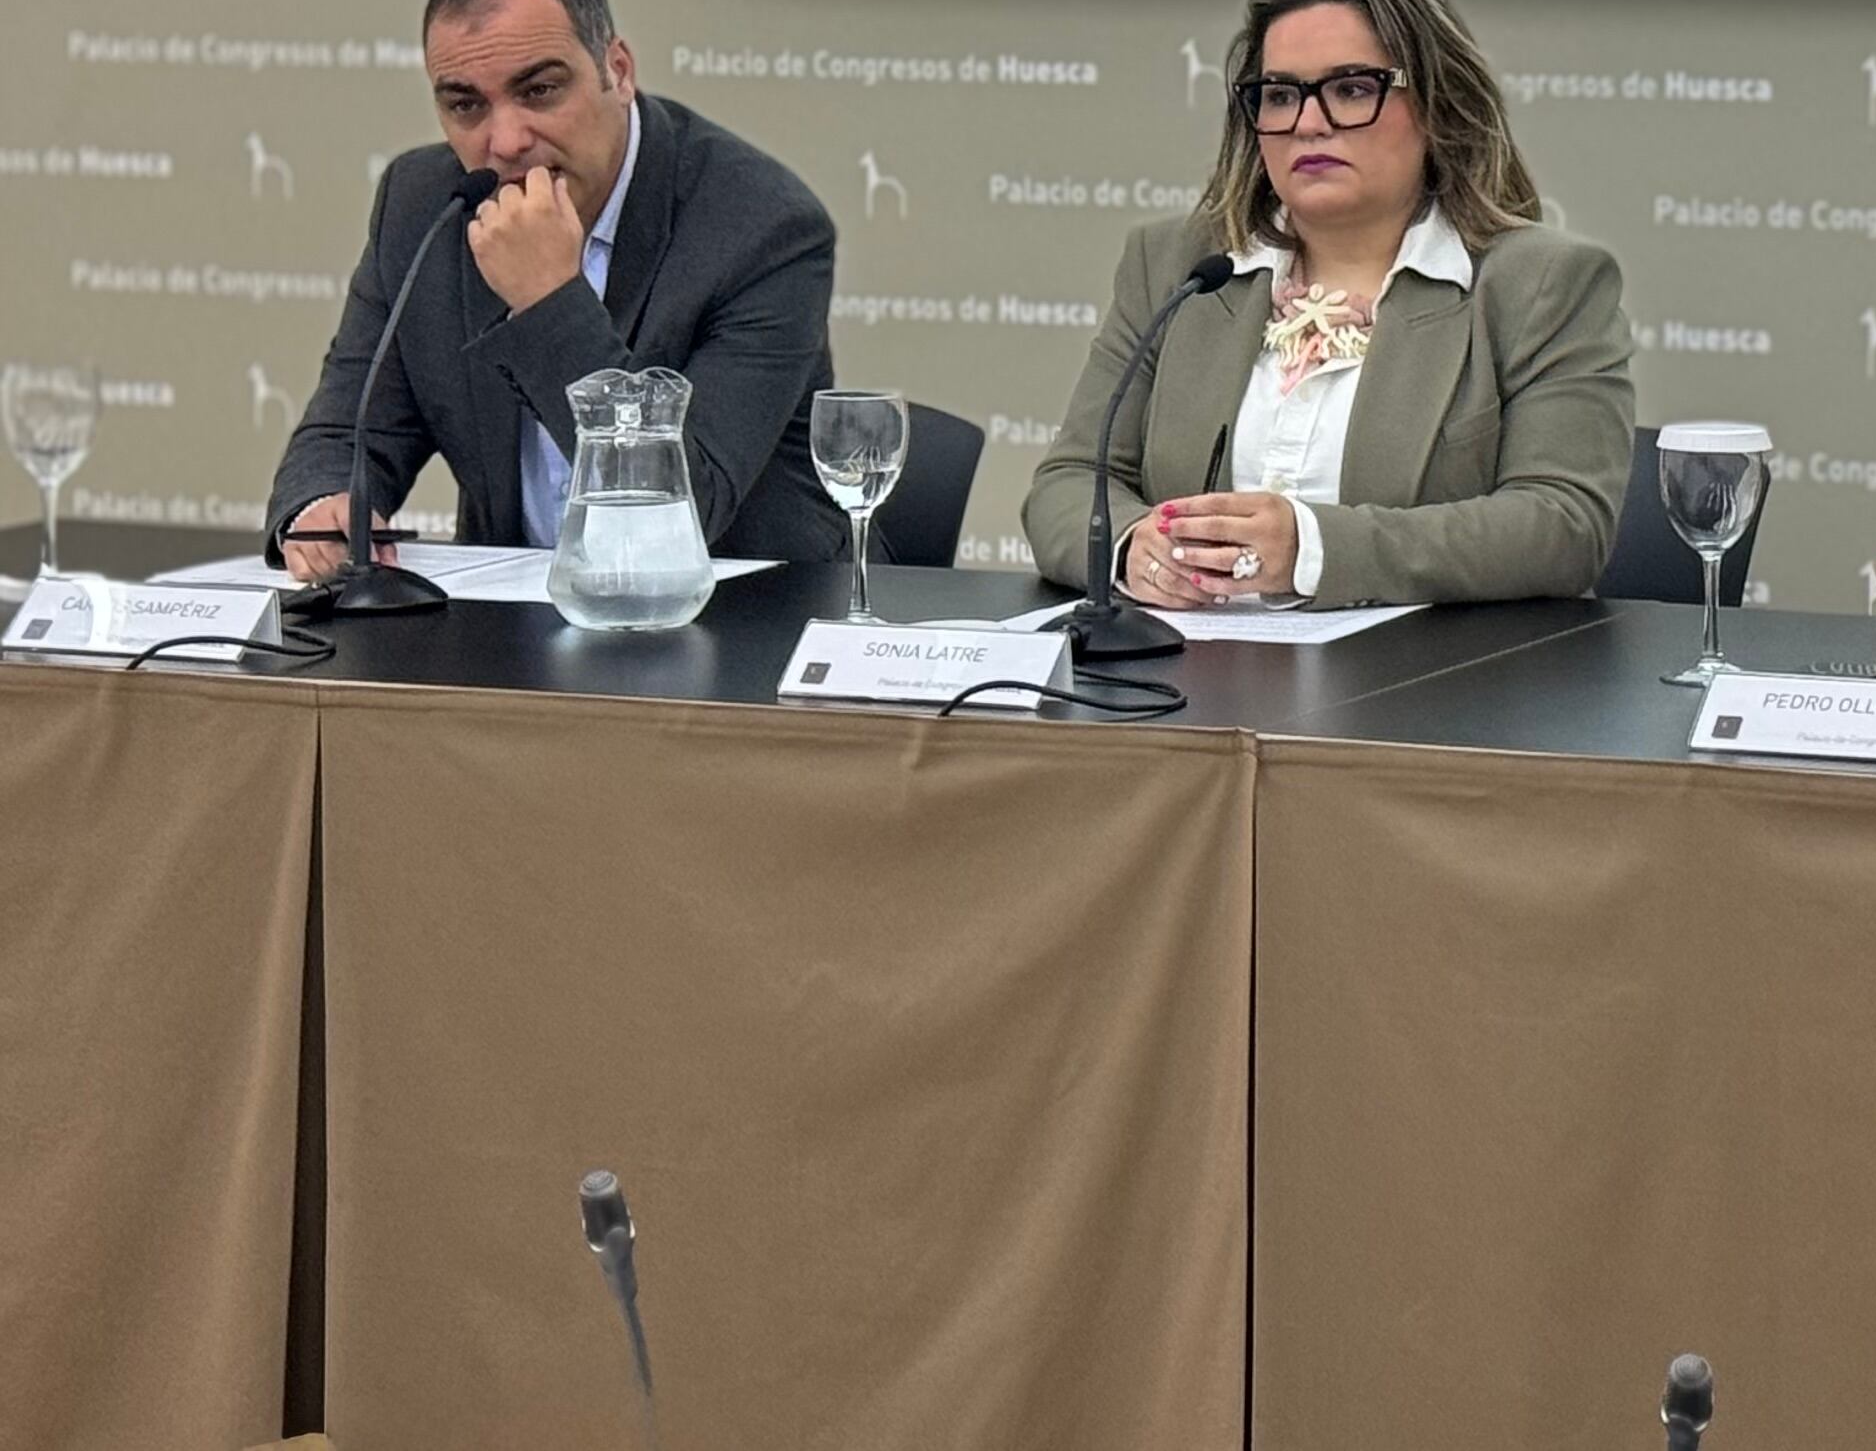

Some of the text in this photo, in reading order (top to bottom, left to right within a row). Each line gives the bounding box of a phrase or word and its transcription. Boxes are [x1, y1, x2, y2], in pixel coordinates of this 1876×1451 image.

[674, 46, 1097, 86] Palacio de Congresos de Huesca
[1622, 72, 1772, 101] de Huesca
[990, 175, 1126, 206] Palacio de
[1654, 196, 1760, 227] Palacio
[1768, 201, 1802, 228] de
[960, 296, 1097, 325] de Huesca
[1664, 322, 1771, 353] Huesca
[131, 600, 221, 619] SAMPÉRIZ
[863, 642, 988, 662] SONIA LATRE
[1763, 693, 1833, 711] PEDRO
